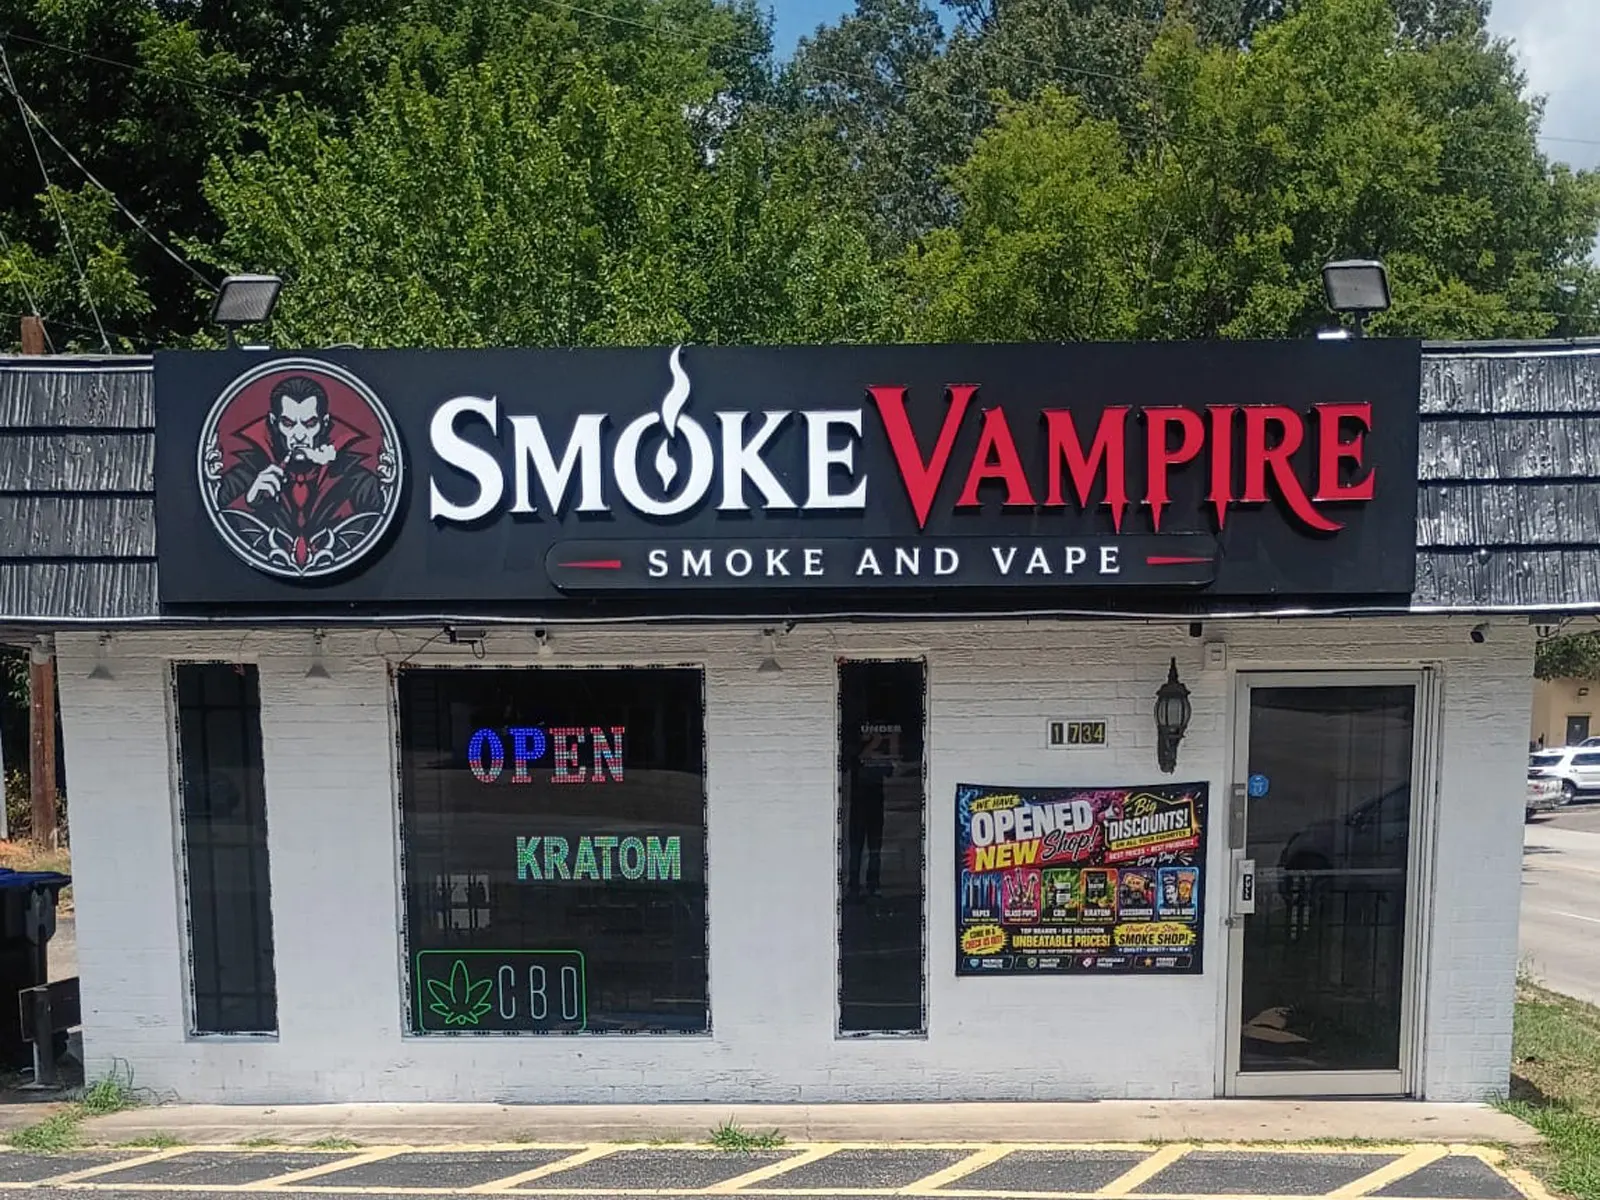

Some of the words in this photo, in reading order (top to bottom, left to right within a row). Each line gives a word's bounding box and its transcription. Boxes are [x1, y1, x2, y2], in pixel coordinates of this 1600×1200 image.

[430, 392, 868, 522] SMOKE
[866, 383, 1375, 533] VAMPIRE
[649, 548, 824, 577] SMOKE
[856, 547, 959, 576] AND
[993, 546, 1120, 575] VAPE
[861, 723, 902, 733] UNDER
[1054, 724, 1104, 743] 1734
[467, 726, 625, 784] OPEN
[976, 800, 988, 810] WE
[993, 797, 1014, 808] HAVE
[1133, 798, 1157, 816] Big
[971, 800, 1093, 847] OPENED
[1109, 808, 1189, 841] DISCOUNTS!
[516, 836, 681, 880] KRATOM
[975, 840, 1040, 872] NEW
[1041, 825, 1100, 861] Shop!
[1137, 855, 1157, 867] Every
[1159, 850, 1178, 863] Day!
[1053, 909, 1066, 917] CBD
[1012, 935, 1073, 947] UNBEATABLE
[1074, 934, 1110, 947] PRICES!
[1119, 933, 1155, 945] SMOKE
[1158, 933, 1188, 945] SHOP!
[498, 965, 578, 1020] CBD
